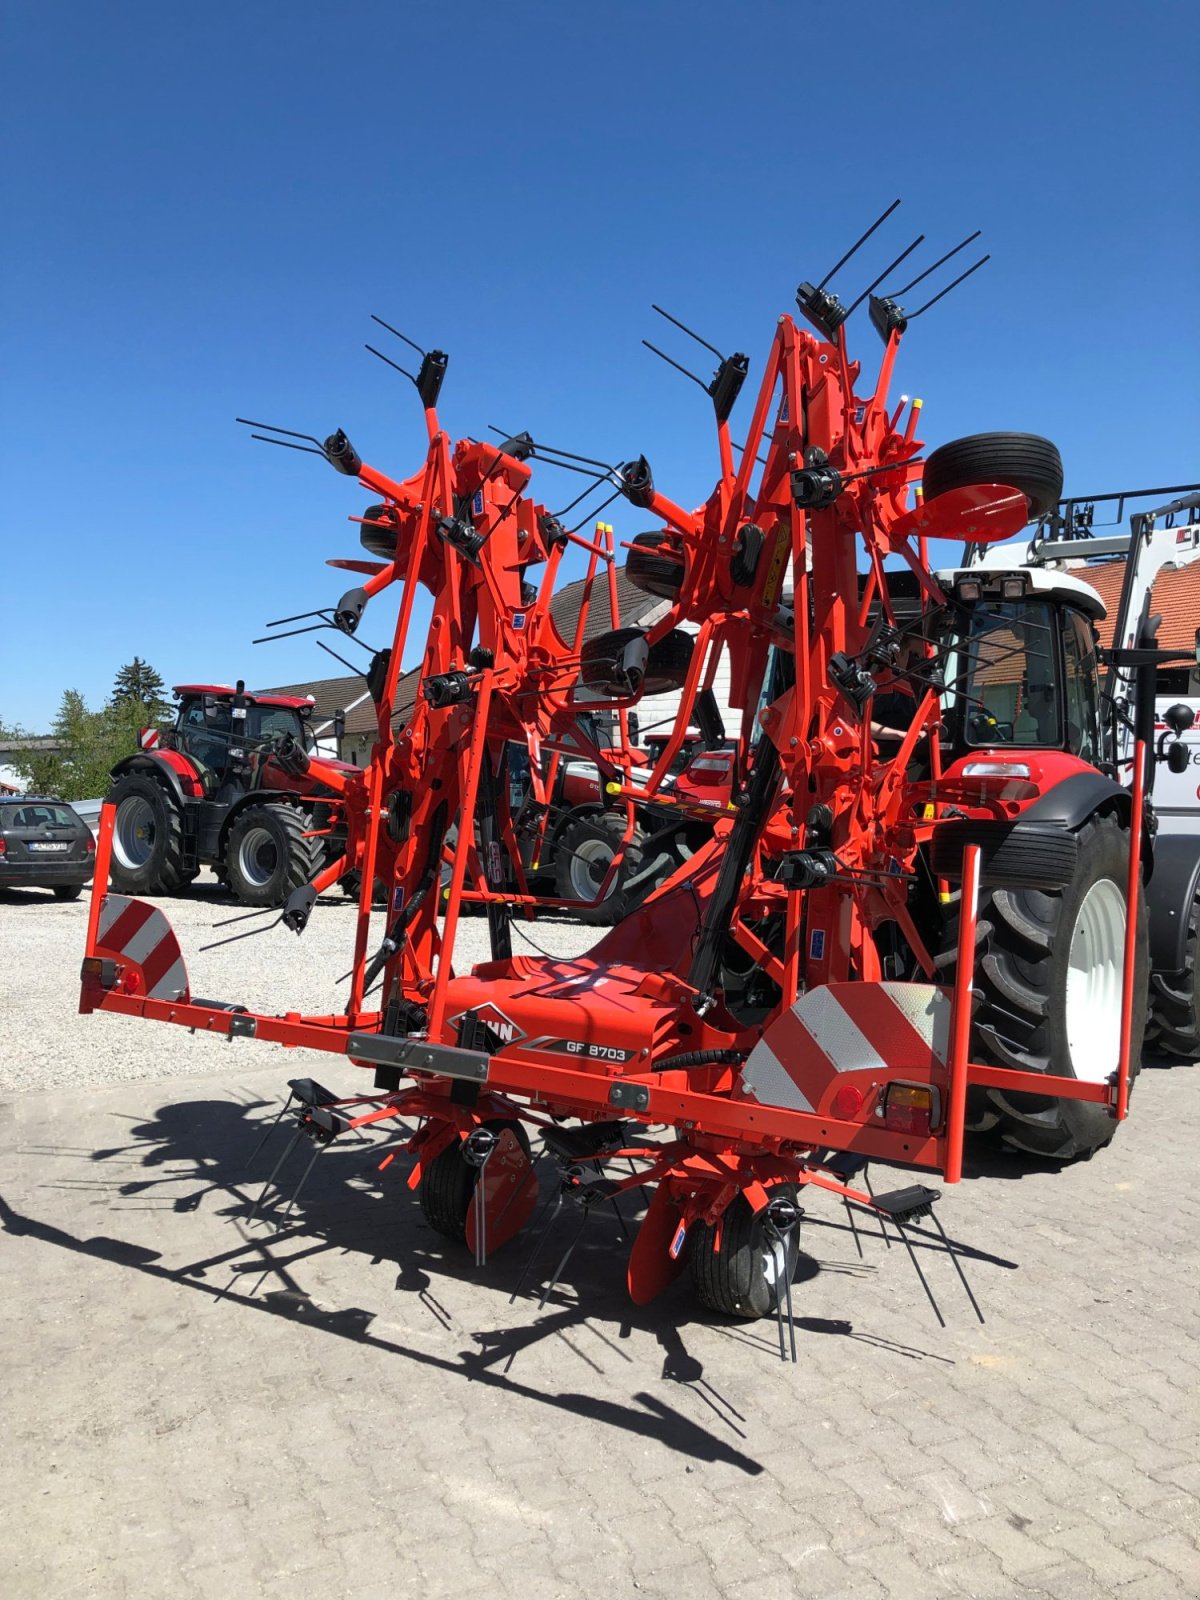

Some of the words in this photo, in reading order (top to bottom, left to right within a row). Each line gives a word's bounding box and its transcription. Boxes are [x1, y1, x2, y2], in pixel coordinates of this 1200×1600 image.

[461, 1015, 513, 1041] HN
[566, 1041, 585, 1053] GF
[589, 1045, 626, 1061] 8703
